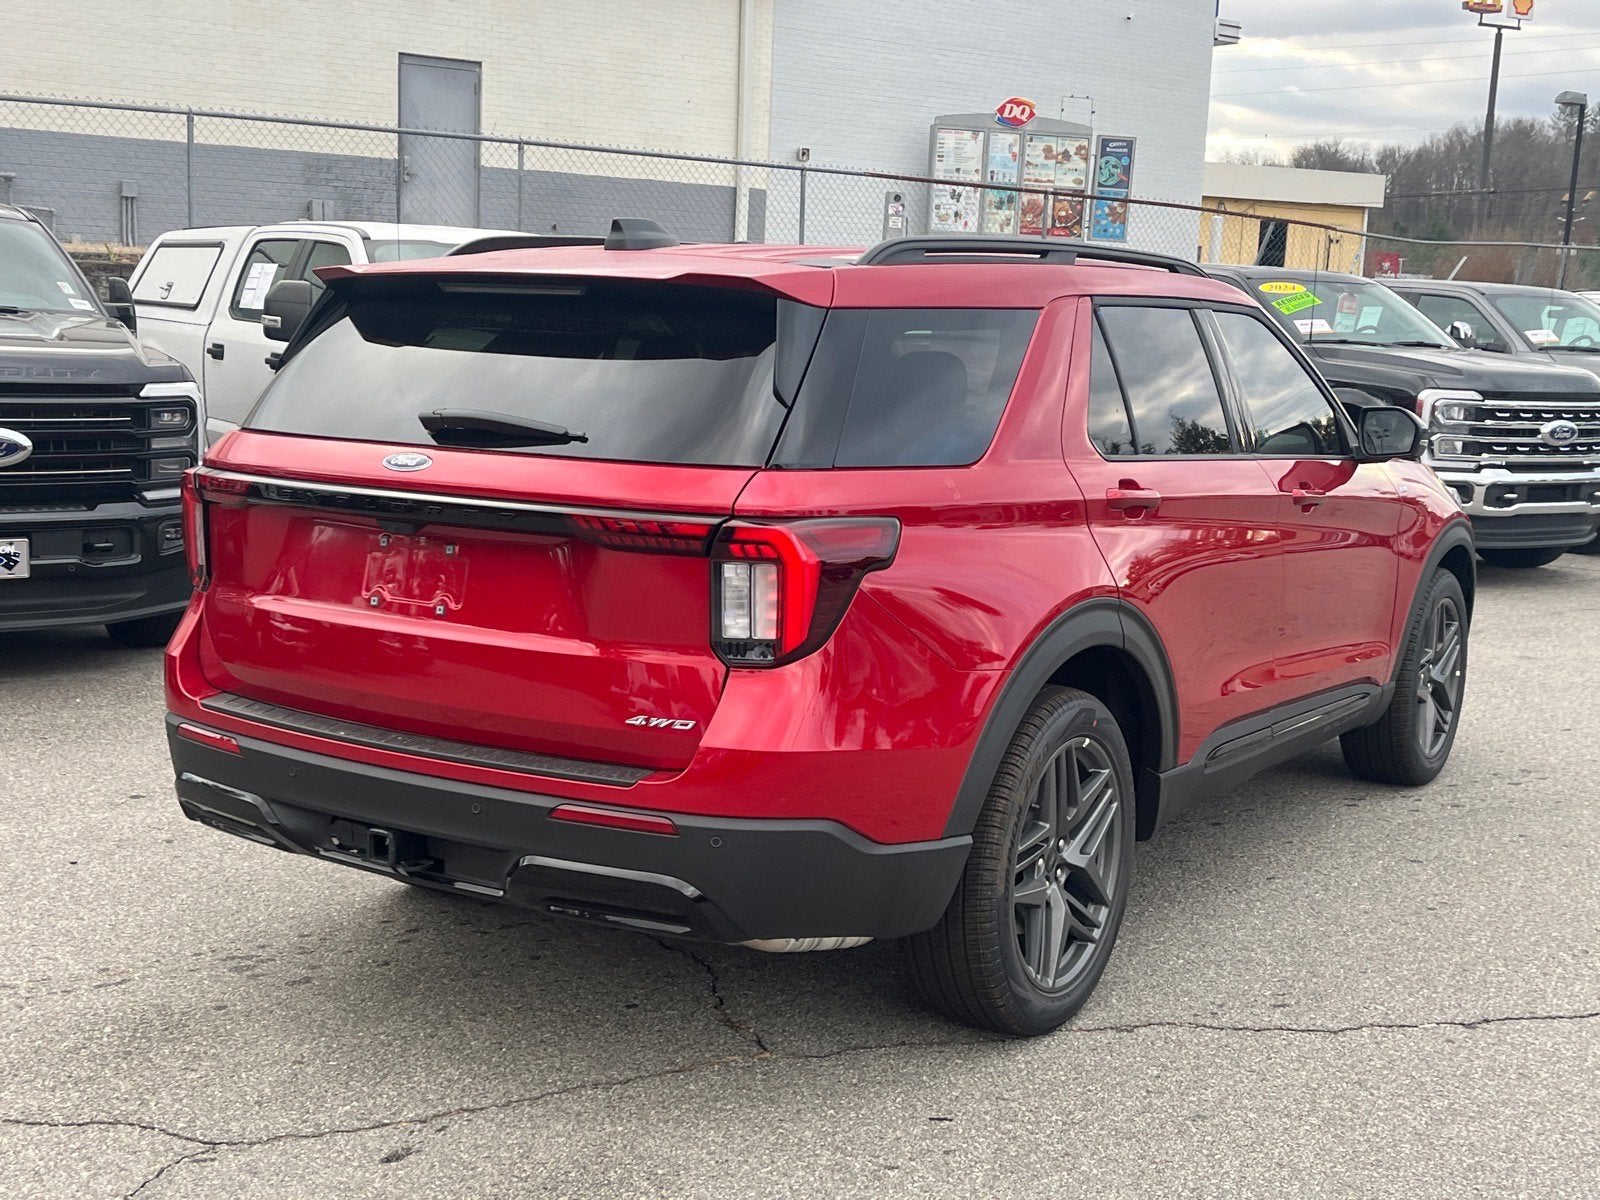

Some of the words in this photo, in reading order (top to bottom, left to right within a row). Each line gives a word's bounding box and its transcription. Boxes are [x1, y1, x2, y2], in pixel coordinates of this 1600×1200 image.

[1002, 103, 1031, 121] DQ
[1275, 292, 1310, 306] REDUCED
[624, 715, 697, 730] 4WD
